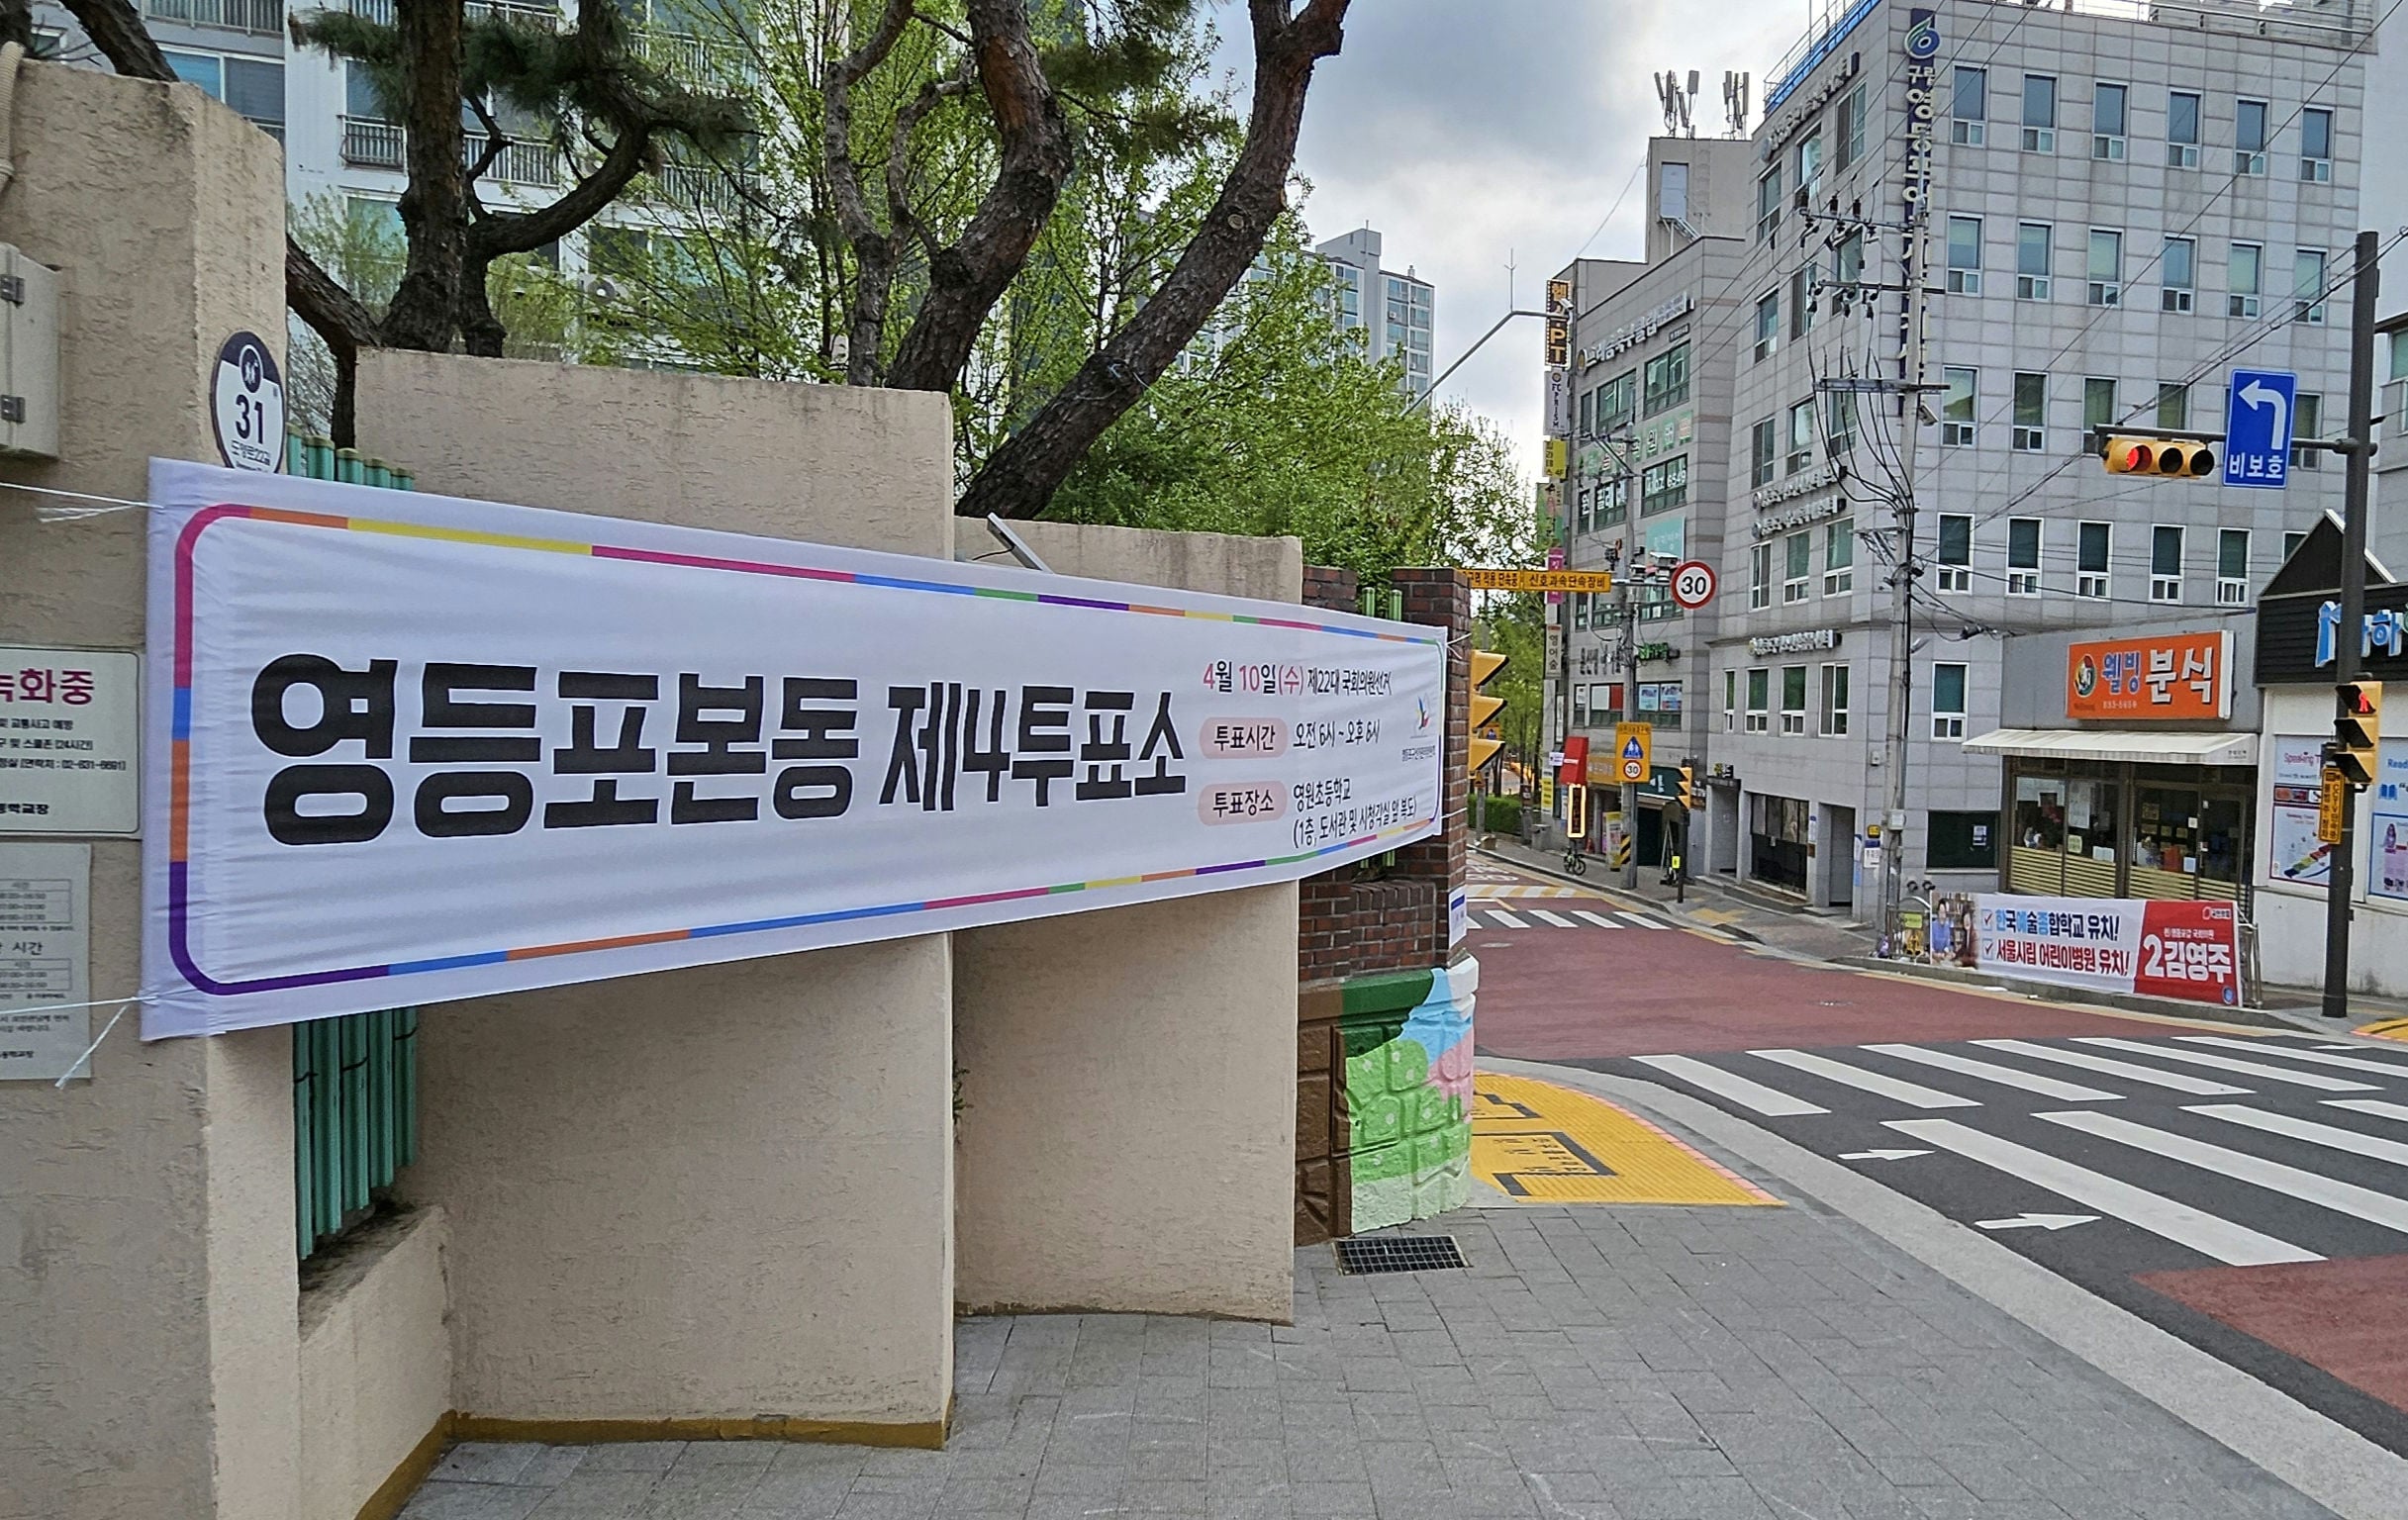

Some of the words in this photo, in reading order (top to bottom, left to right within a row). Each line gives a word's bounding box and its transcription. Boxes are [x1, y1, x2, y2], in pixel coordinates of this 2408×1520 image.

[236, 394, 263, 444] 31
[2229, 452, 2283, 479] 비보호
[1498, 572, 1517, 587] 단속중
[1529, 572, 1605, 589] 신호과속단속장비
[1681, 575, 1706, 596] 30
[1203, 660, 1232, 693] 4월
[1239, 664, 1303, 696] 10일(수)
[1306, 667, 1340, 696] 제22대
[1342, 669, 1394, 696] 국회의원선거
[2101, 650, 2141, 695] 웰빙
[2145, 646, 2214, 705] 분식
[250, 652, 861, 845] 영등포본동
[878, 681, 1188, 813] 제4투표소
[1213, 724, 1276, 752] 투표시간
[1293, 721, 1316, 749] 오전
[1346, 718, 1364, 744] 오후
[1627, 765, 1639, 774] 30
[1212, 789, 1275, 818] 투표장소
[1293, 777, 1351, 812] 영원초등학교
[1319, 810, 1348, 840] 도서관
[1349, 808, 1358, 834] 및
[1995, 908, 2084, 939] 한국예술종합학교
[2087, 914, 2120, 941] 유치!
[12, 941, 43, 956] 시간
[1995, 939, 2036, 966] 서울시립
[2039, 943, 2096, 973] 어린이병원
[2099, 949, 2131, 977] 유치!
[2143, 933, 2165, 978] 2
[2164, 941, 2232, 984] 김영주
